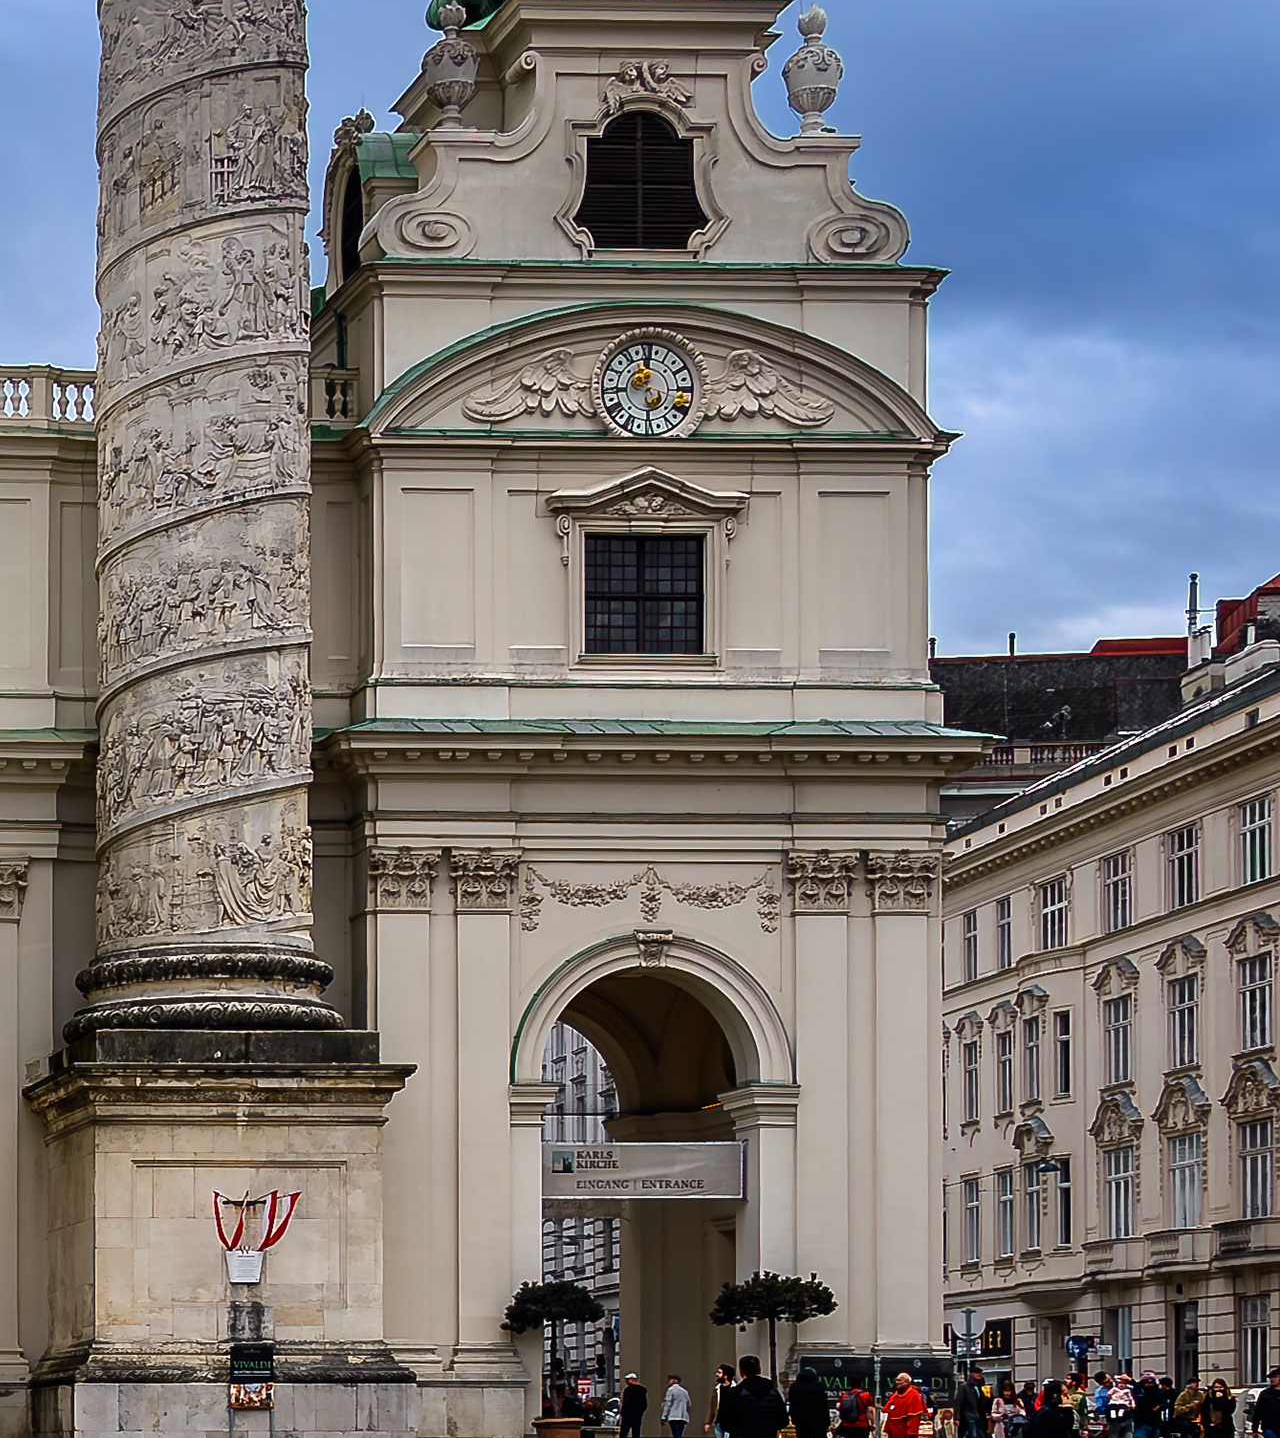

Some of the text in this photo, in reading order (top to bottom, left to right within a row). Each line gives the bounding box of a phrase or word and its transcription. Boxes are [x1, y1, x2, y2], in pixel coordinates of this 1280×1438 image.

[576, 1150, 614, 1160] KARLS
[576, 1160, 619, 1169] KIRCHE
[576, 1179, 705, 1190] EINGANG ENTRANCE
